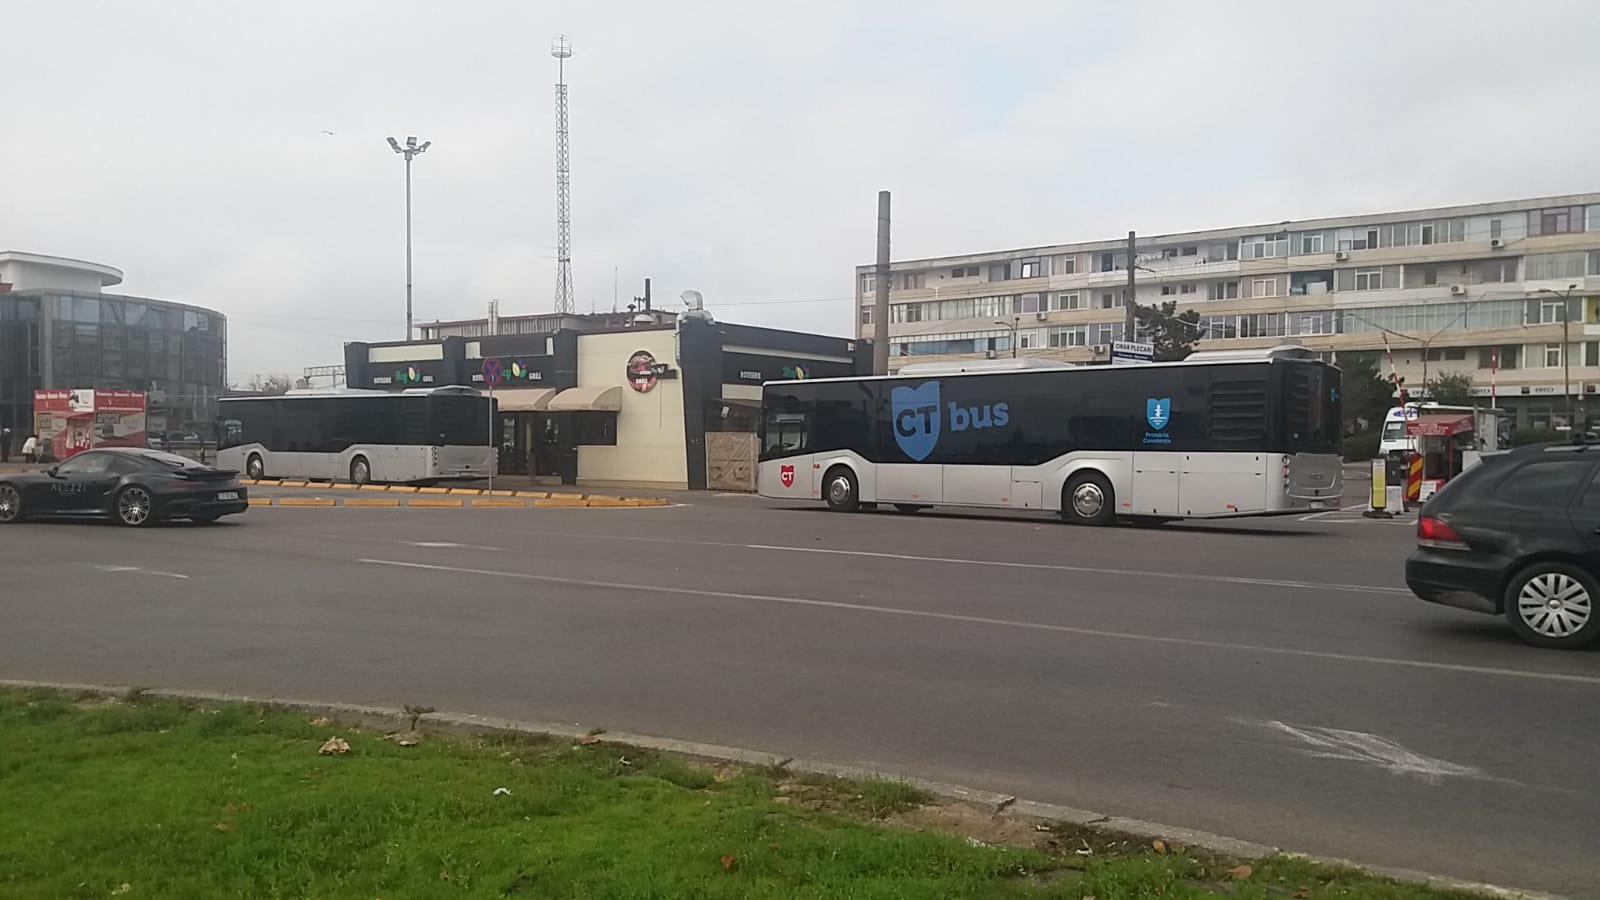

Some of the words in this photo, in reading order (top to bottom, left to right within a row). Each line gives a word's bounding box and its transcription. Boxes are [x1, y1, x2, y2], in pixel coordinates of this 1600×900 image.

[895, 405, 938, 437] CT
[948, 402, 1009, 431] bus
[781, 471, 794, 481] CT
